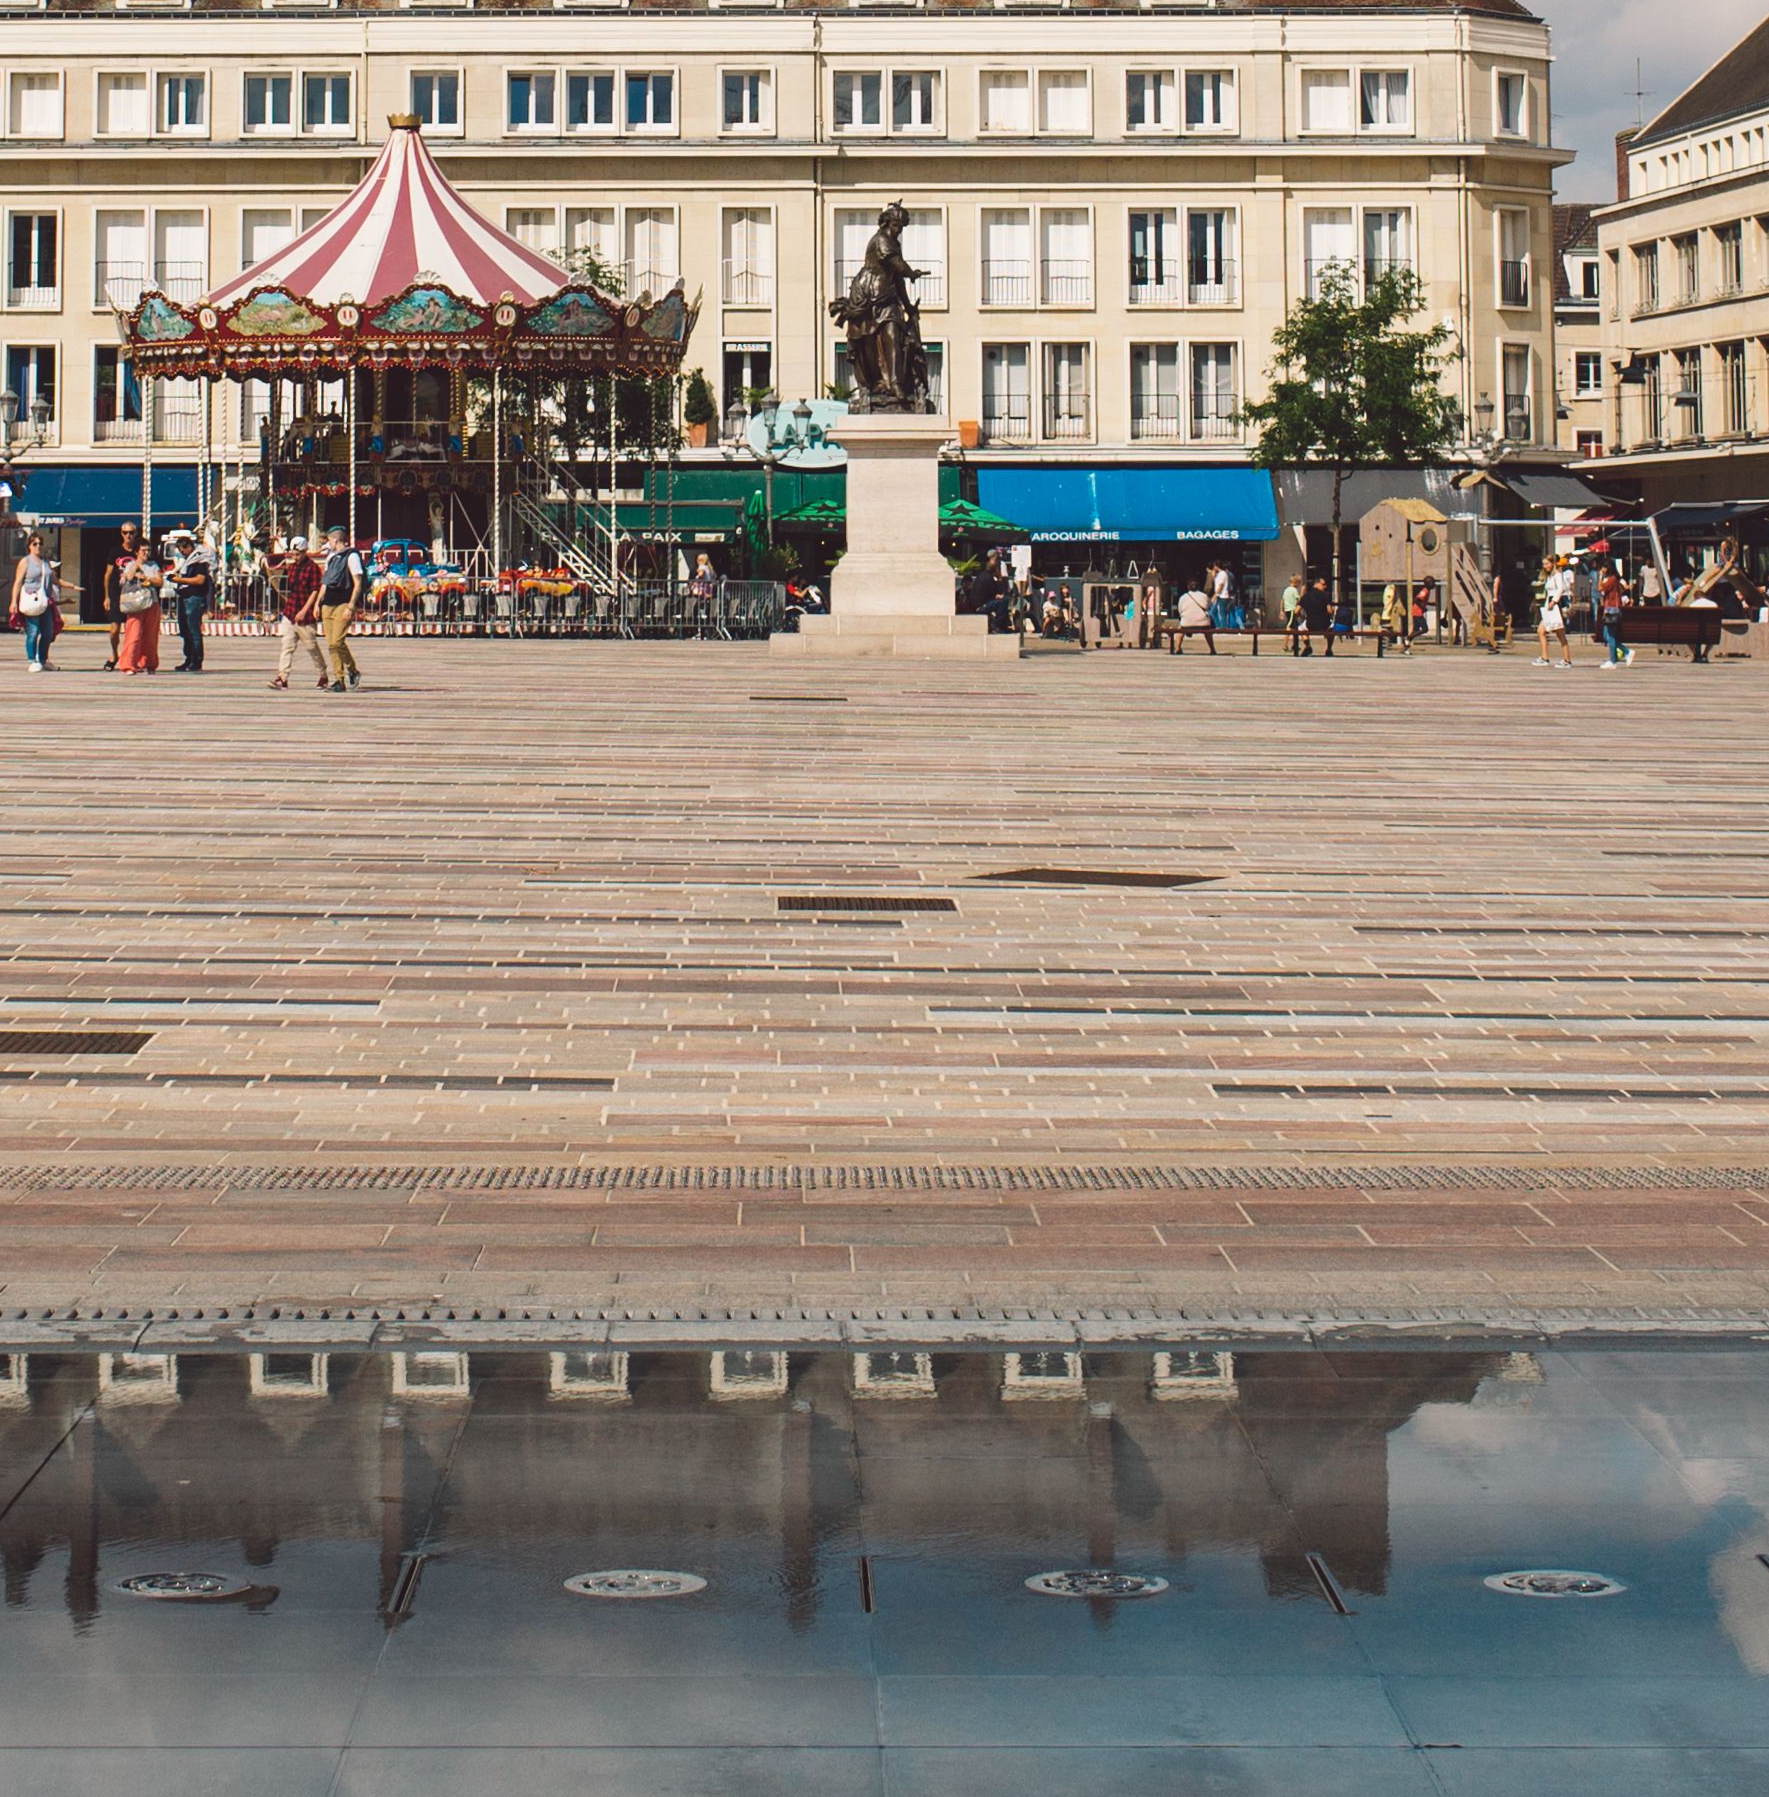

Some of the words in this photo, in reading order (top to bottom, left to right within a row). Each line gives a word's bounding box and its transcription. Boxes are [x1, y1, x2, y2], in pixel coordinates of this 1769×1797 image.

[725, 343, 769, 352] BRASSERIE
[641, 532, 683, 543] PAIX
[1030, 530, 1120, 542] AROQUINERIE
[1176, 529, 1240, 541] BAGAGES
